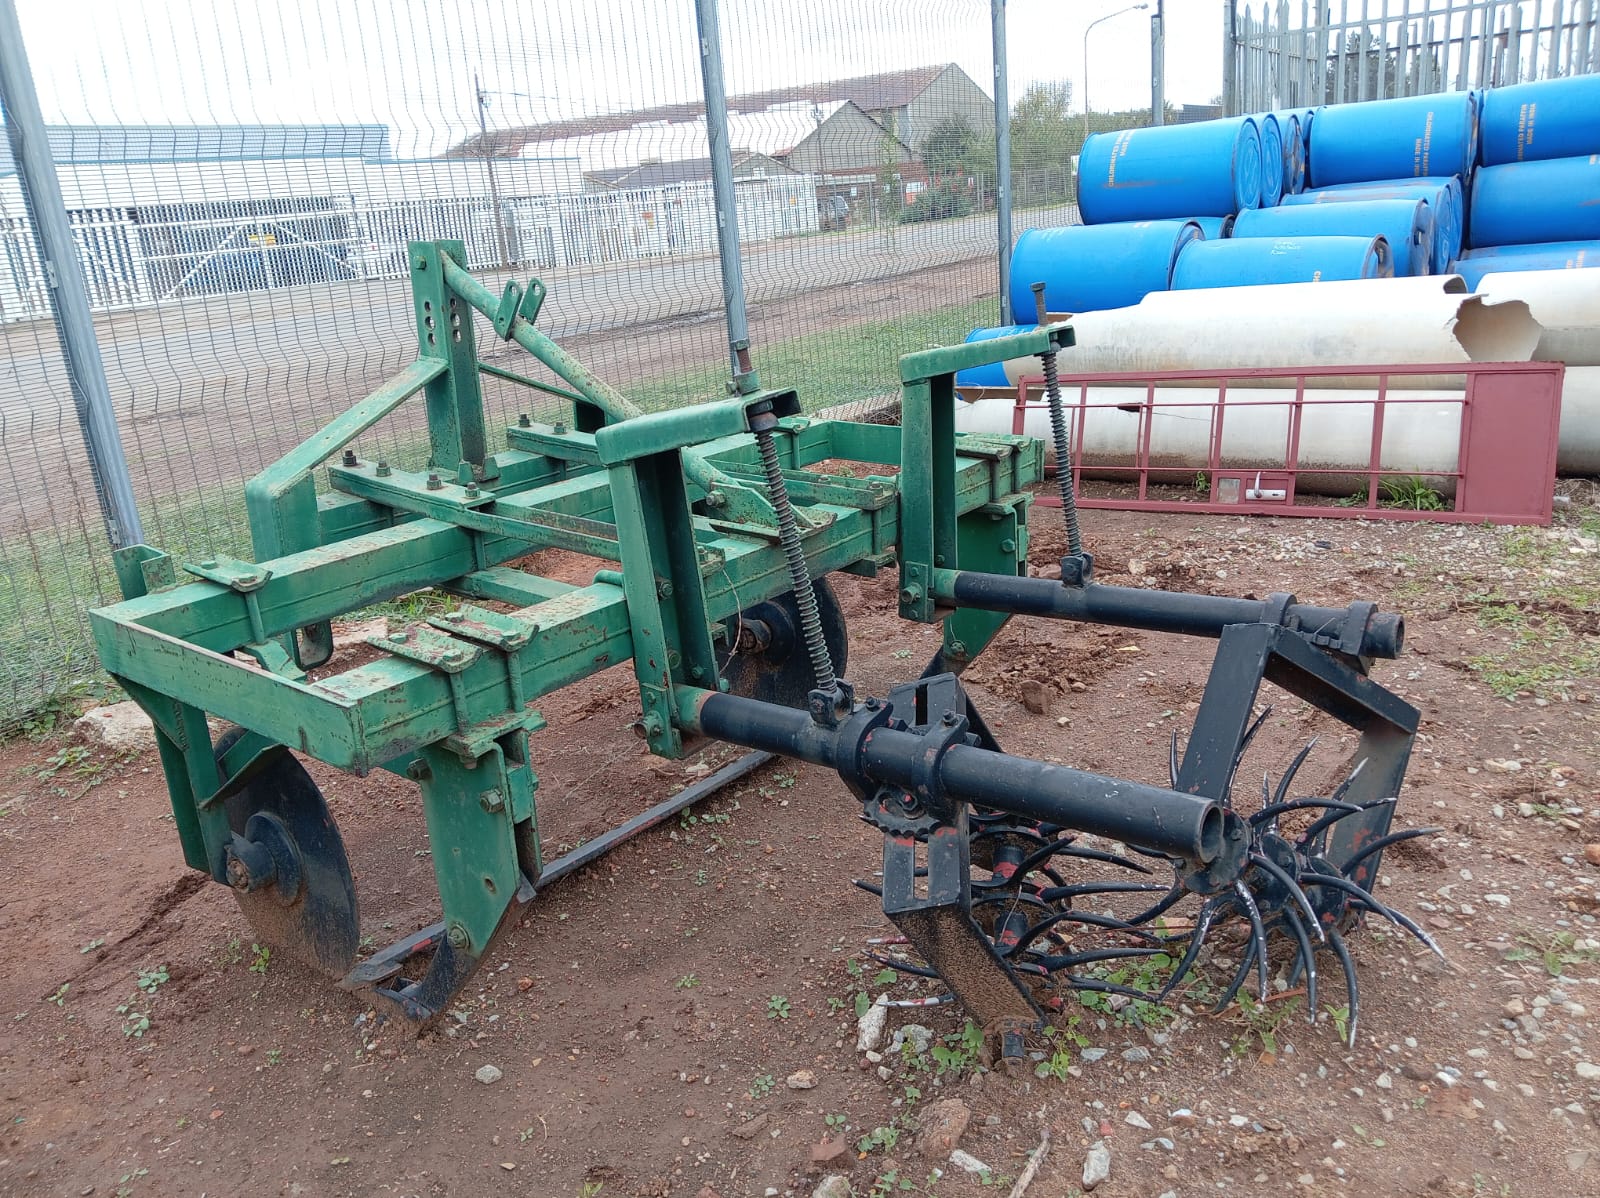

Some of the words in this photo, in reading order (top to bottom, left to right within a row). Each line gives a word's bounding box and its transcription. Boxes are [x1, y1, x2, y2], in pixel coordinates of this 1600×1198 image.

[1424, 112, 1434, 151] CHLORINATED
[1518, 104, 1527, 132] PARAFFIN
[1108, 144, 1119, 187] CHLORINATED
